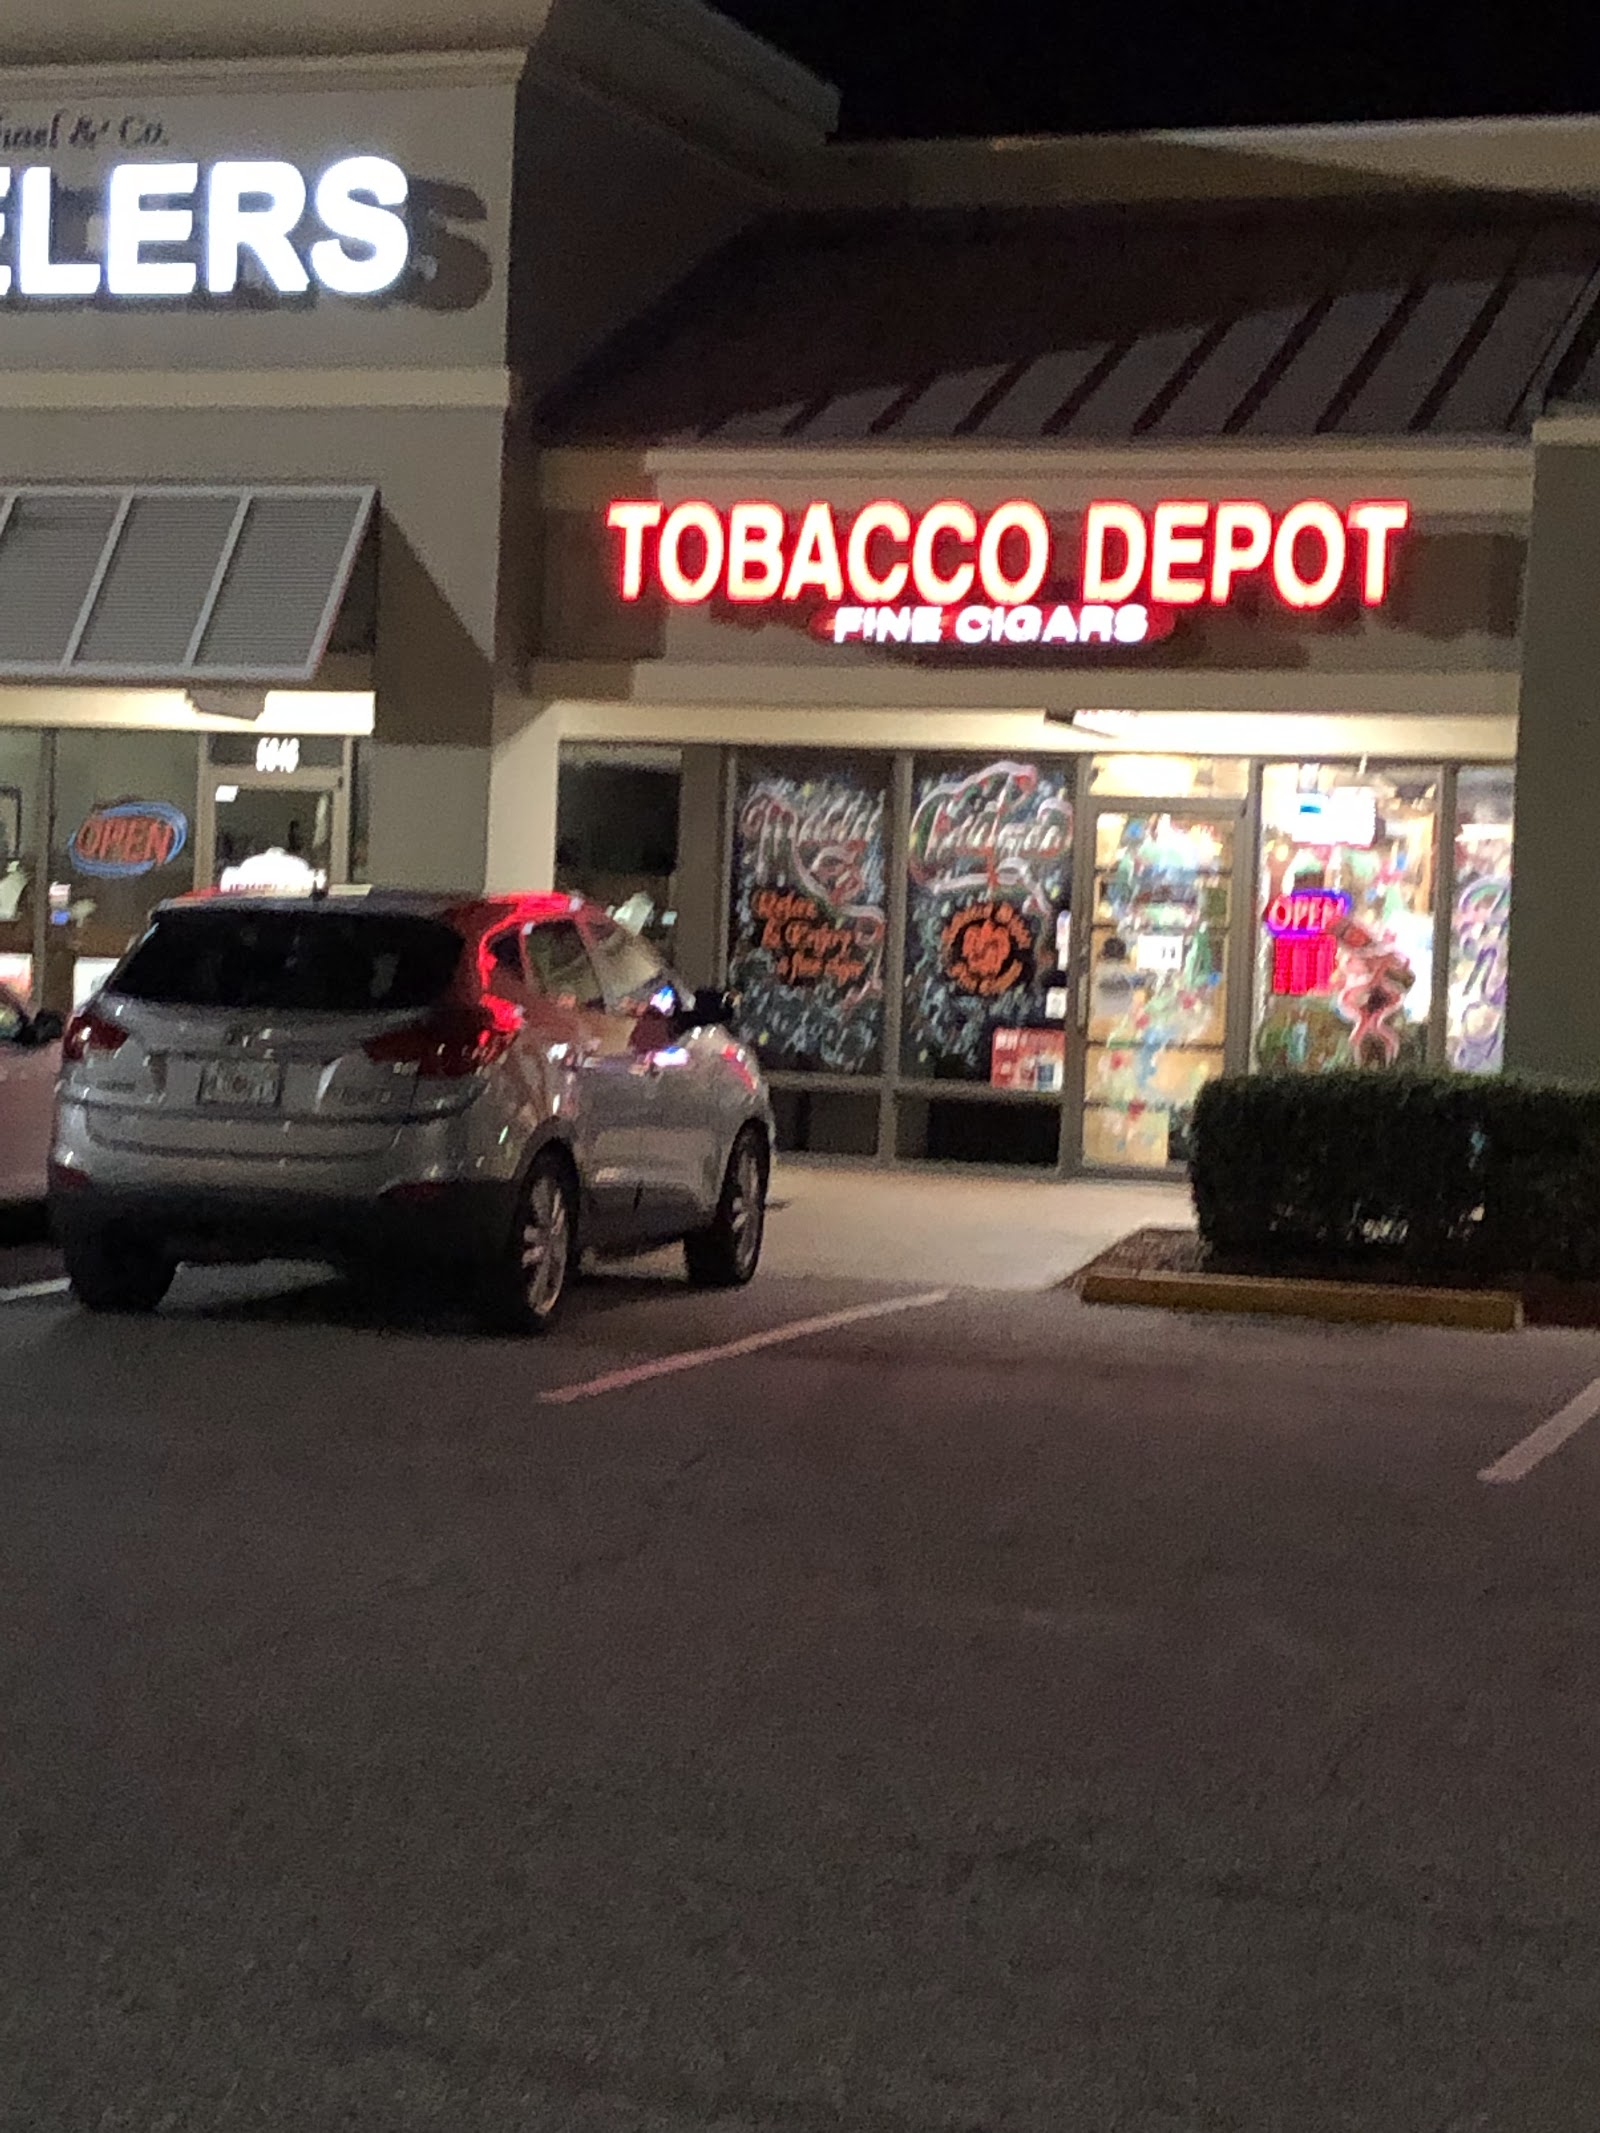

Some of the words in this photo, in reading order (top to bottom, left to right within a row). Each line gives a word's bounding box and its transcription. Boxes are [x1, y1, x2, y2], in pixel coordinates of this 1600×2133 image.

[0, 155, 409, 295] LERS
[606, 497, 1051, 606] TOBACCO
[1082, 497, 1411, 610] DEPOT
[834, 605, 943, 644] FINE
[954, 603, 1149, 644] CIGARS
[75, 815, 173, 866] OPEN
